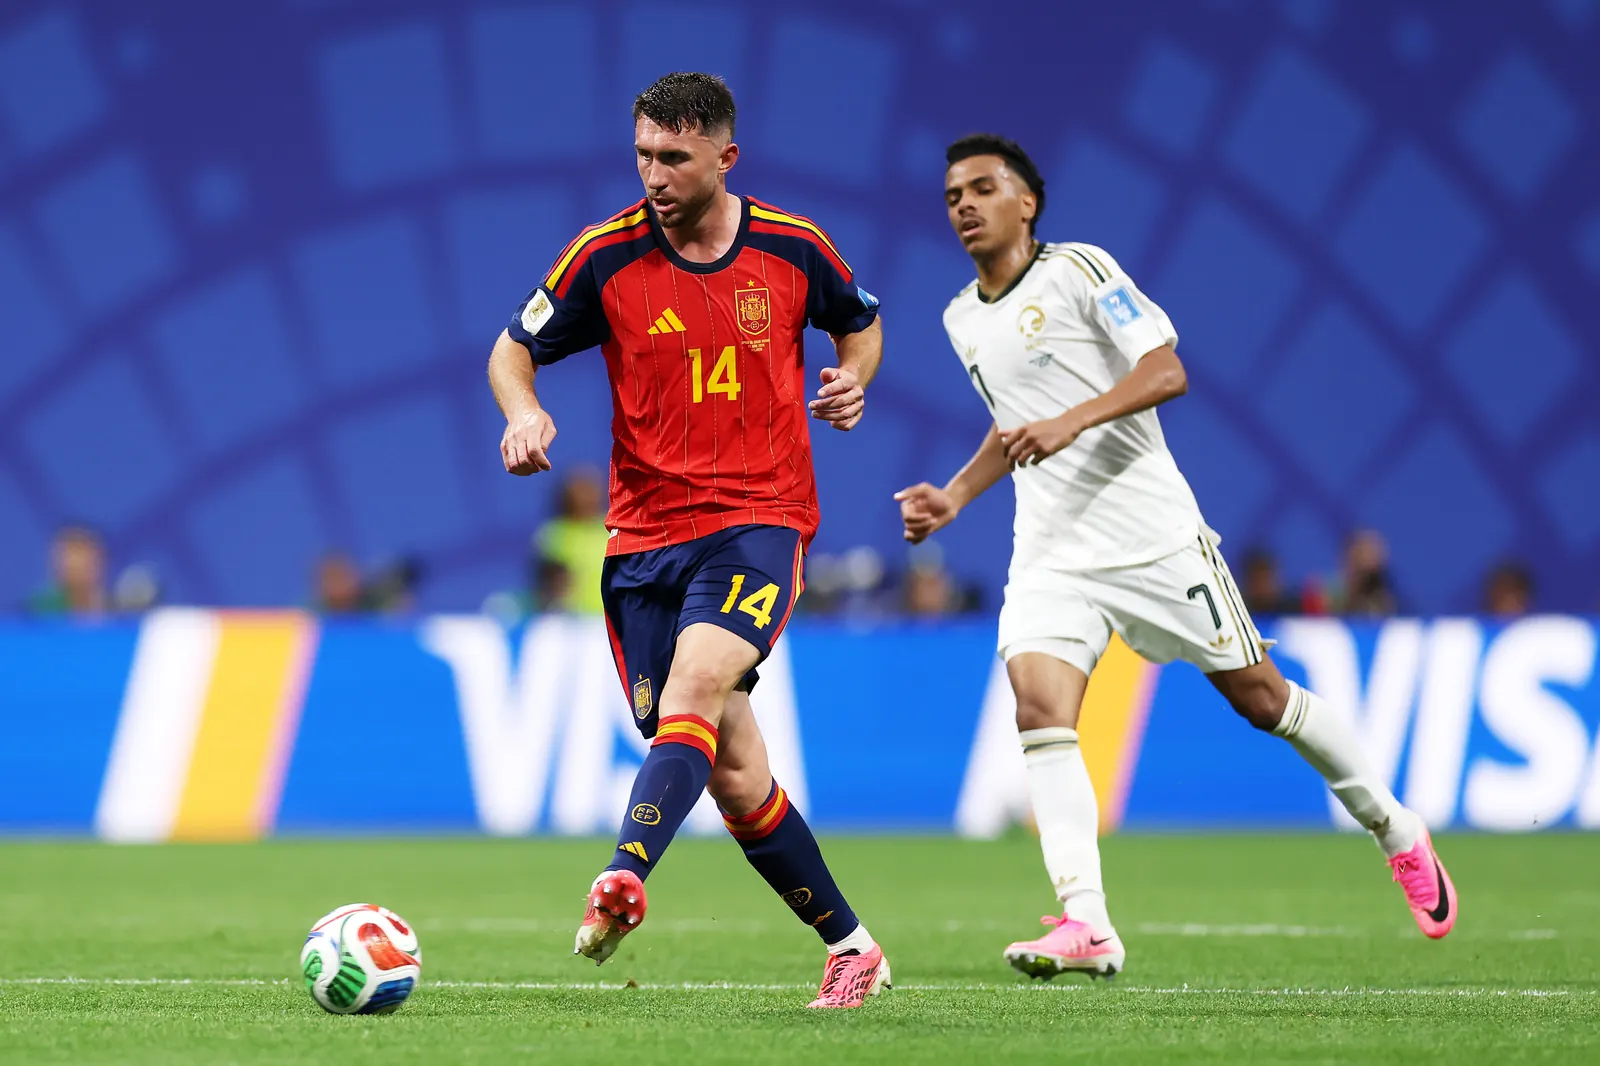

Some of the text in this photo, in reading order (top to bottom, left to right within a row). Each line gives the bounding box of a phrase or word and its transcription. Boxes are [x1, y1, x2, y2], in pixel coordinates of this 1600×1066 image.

[688, 346, 742, 403] 14
[720, 574, 780, 629] 14
[1187, 583, 1221, 630] 7
[1272, 614, 1600, 834] VIS
